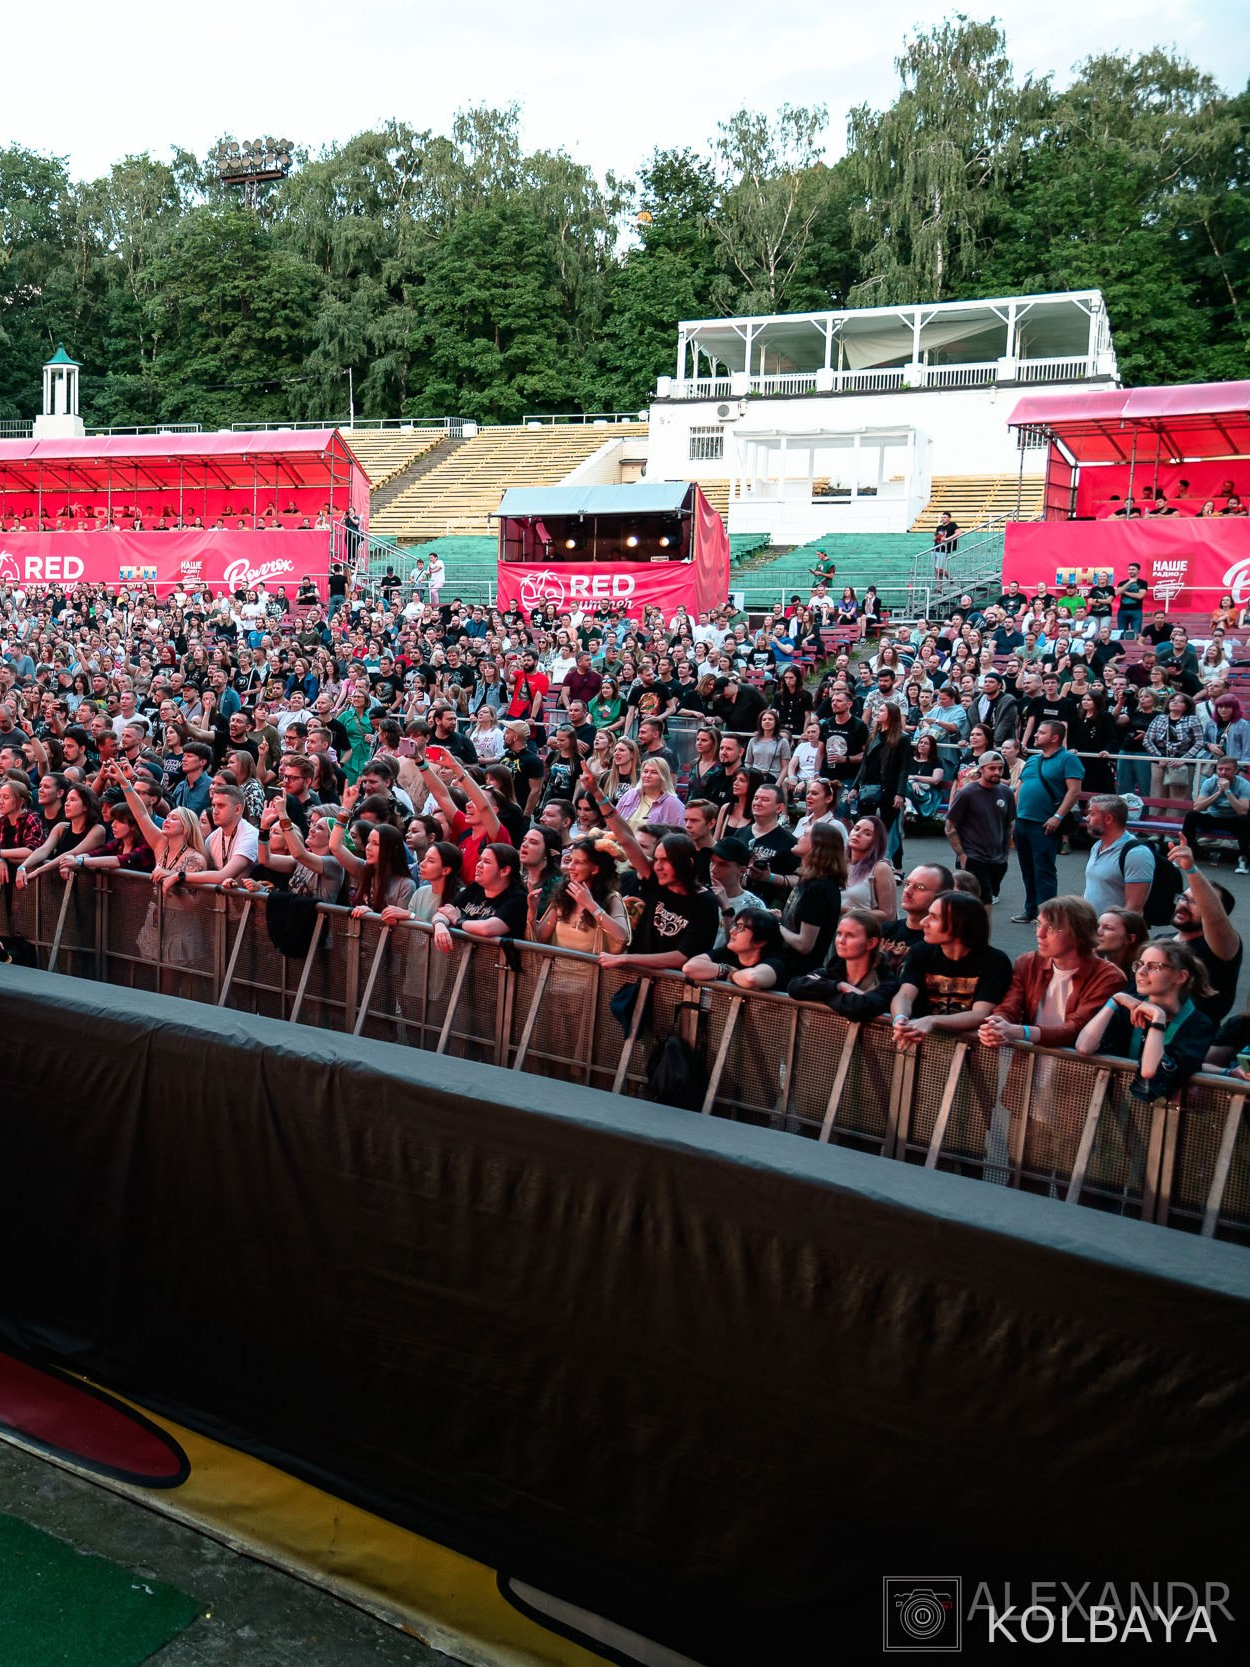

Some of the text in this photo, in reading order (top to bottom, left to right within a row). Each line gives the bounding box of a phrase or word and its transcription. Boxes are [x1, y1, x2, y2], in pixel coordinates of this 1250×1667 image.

[25, 556, 85, 580] RED
[181, 561, 203, 570] НАШЕ
[1152, 560, 1188, 571] НАШЕ
[569, 574, 636, 597] RED
